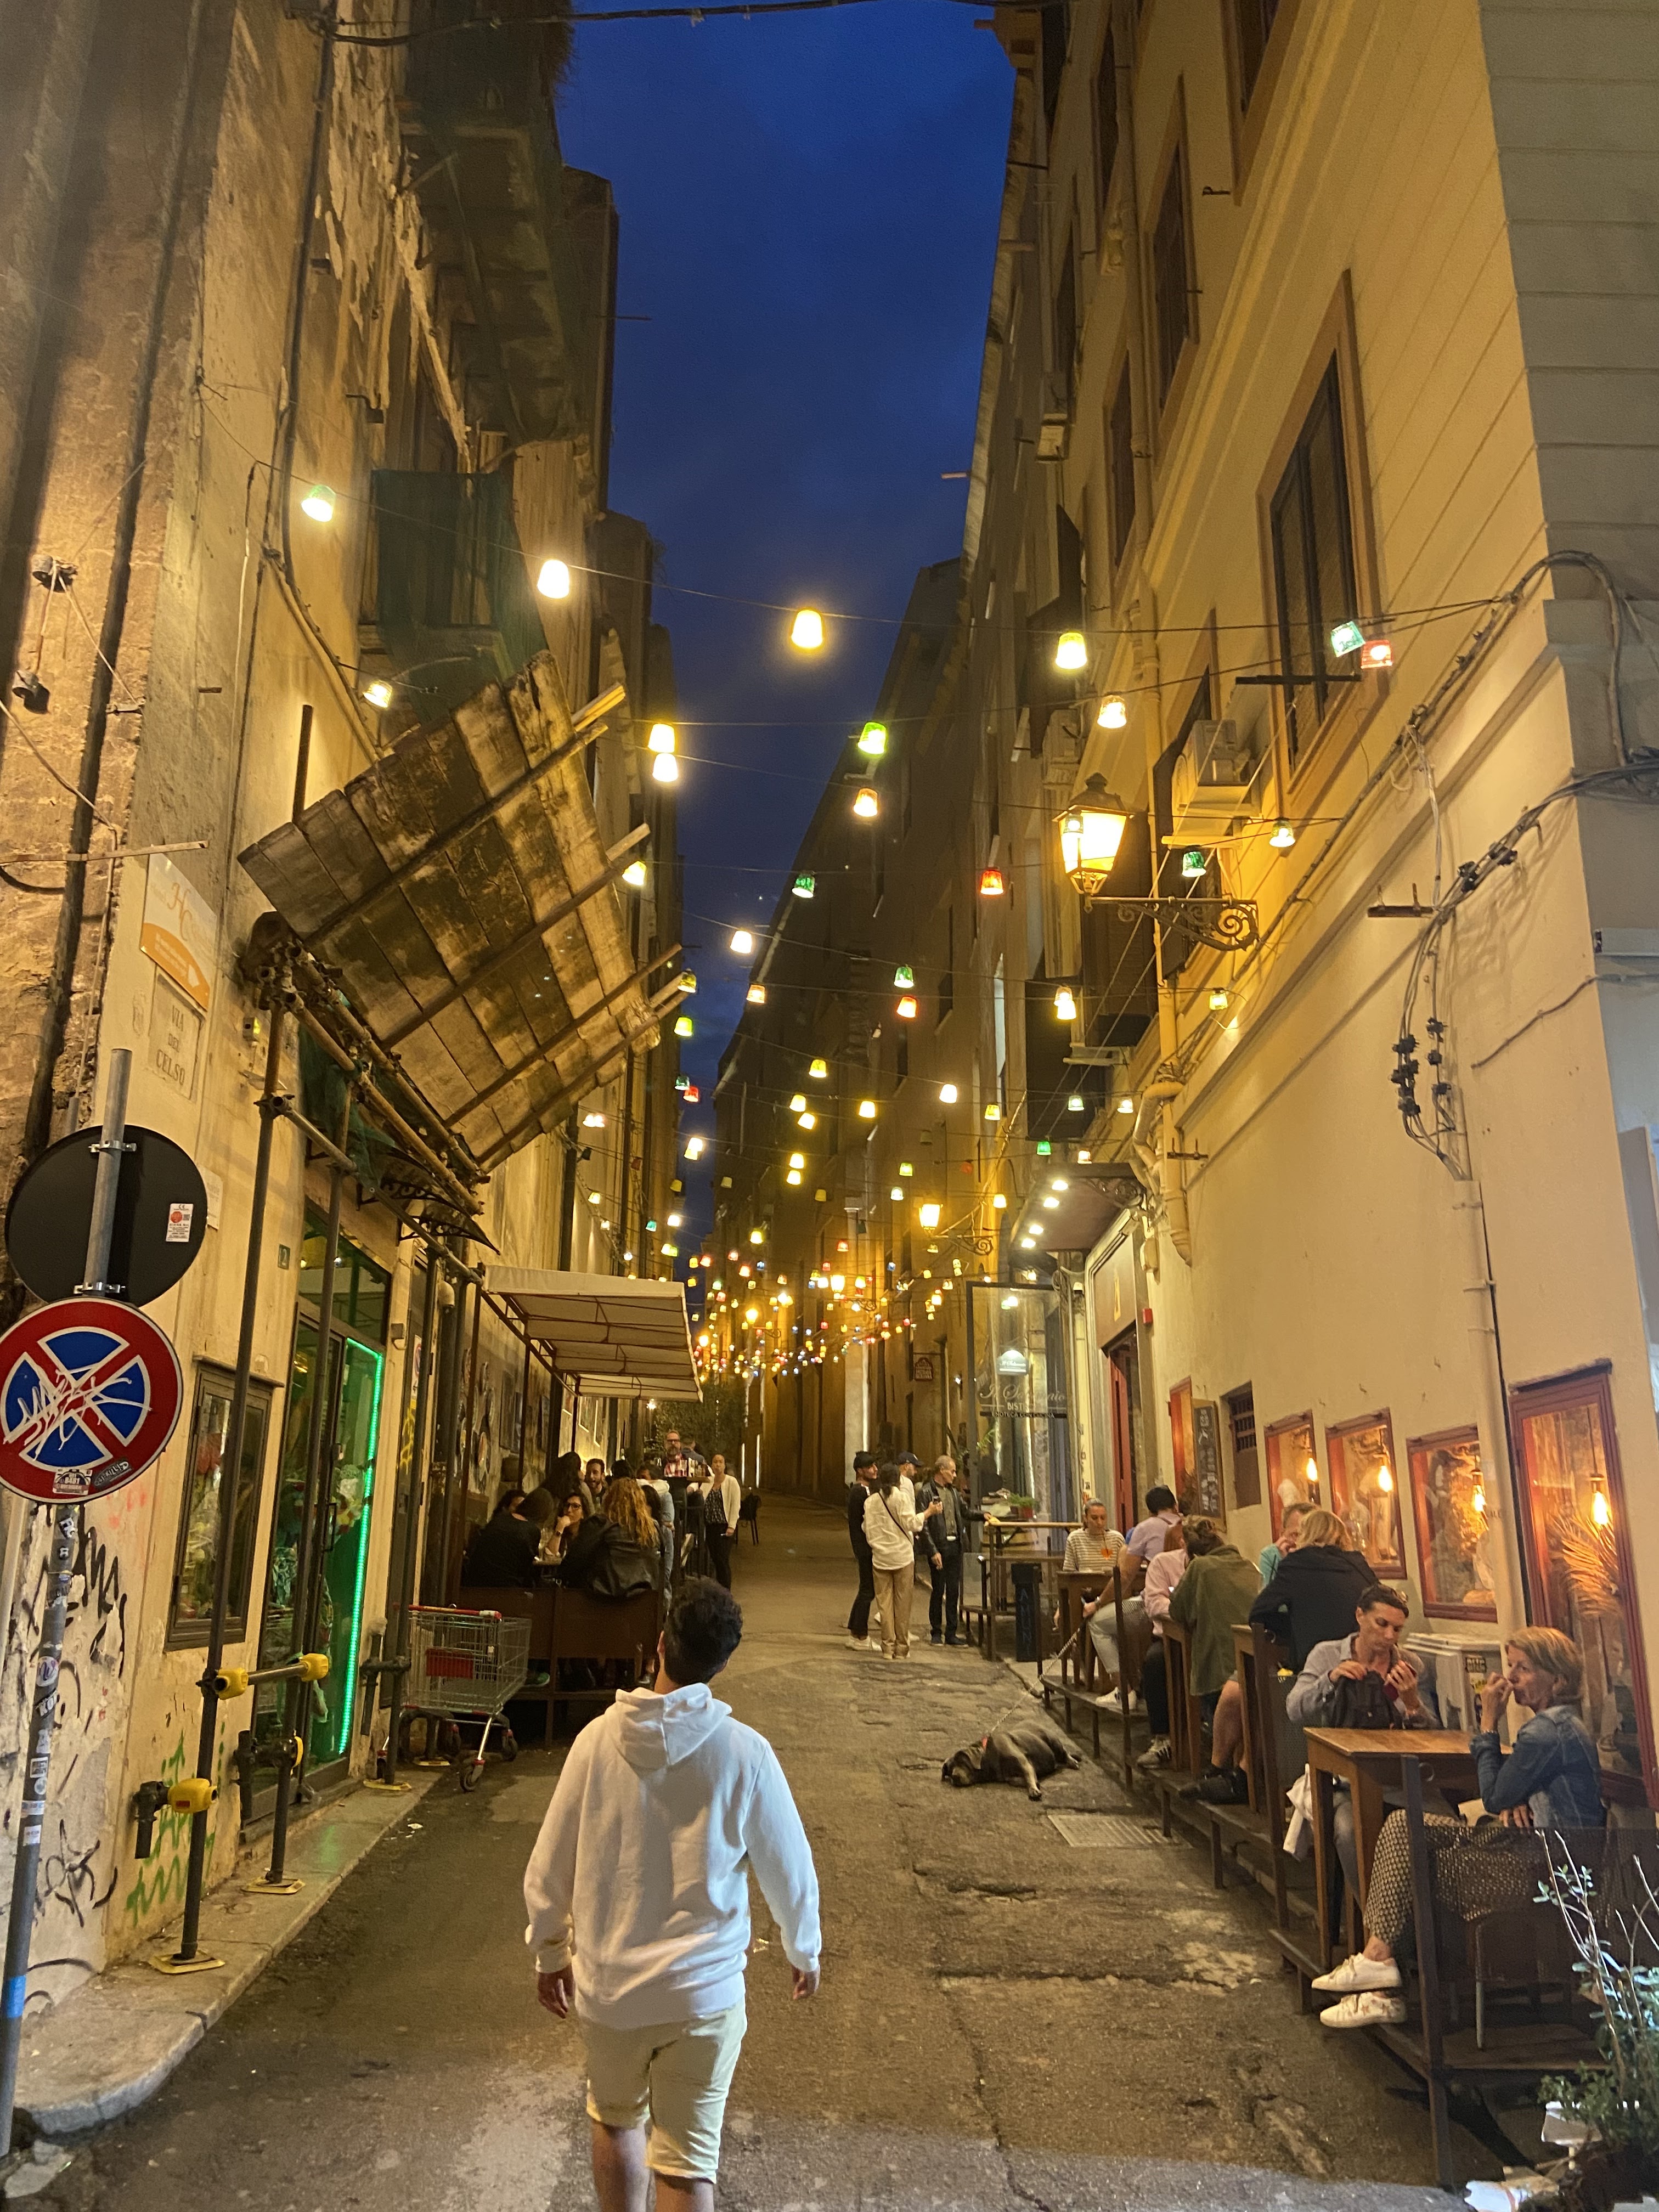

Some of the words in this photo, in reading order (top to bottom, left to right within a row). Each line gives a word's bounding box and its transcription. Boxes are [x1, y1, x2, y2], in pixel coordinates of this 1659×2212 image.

[172, 1005, 184, 1032] VIA
[168, 1032, 180, 1053] DEL
[156, 1048, 185, 1086] CELSO
[1007, 1402, 1036, 1412] BISTR
